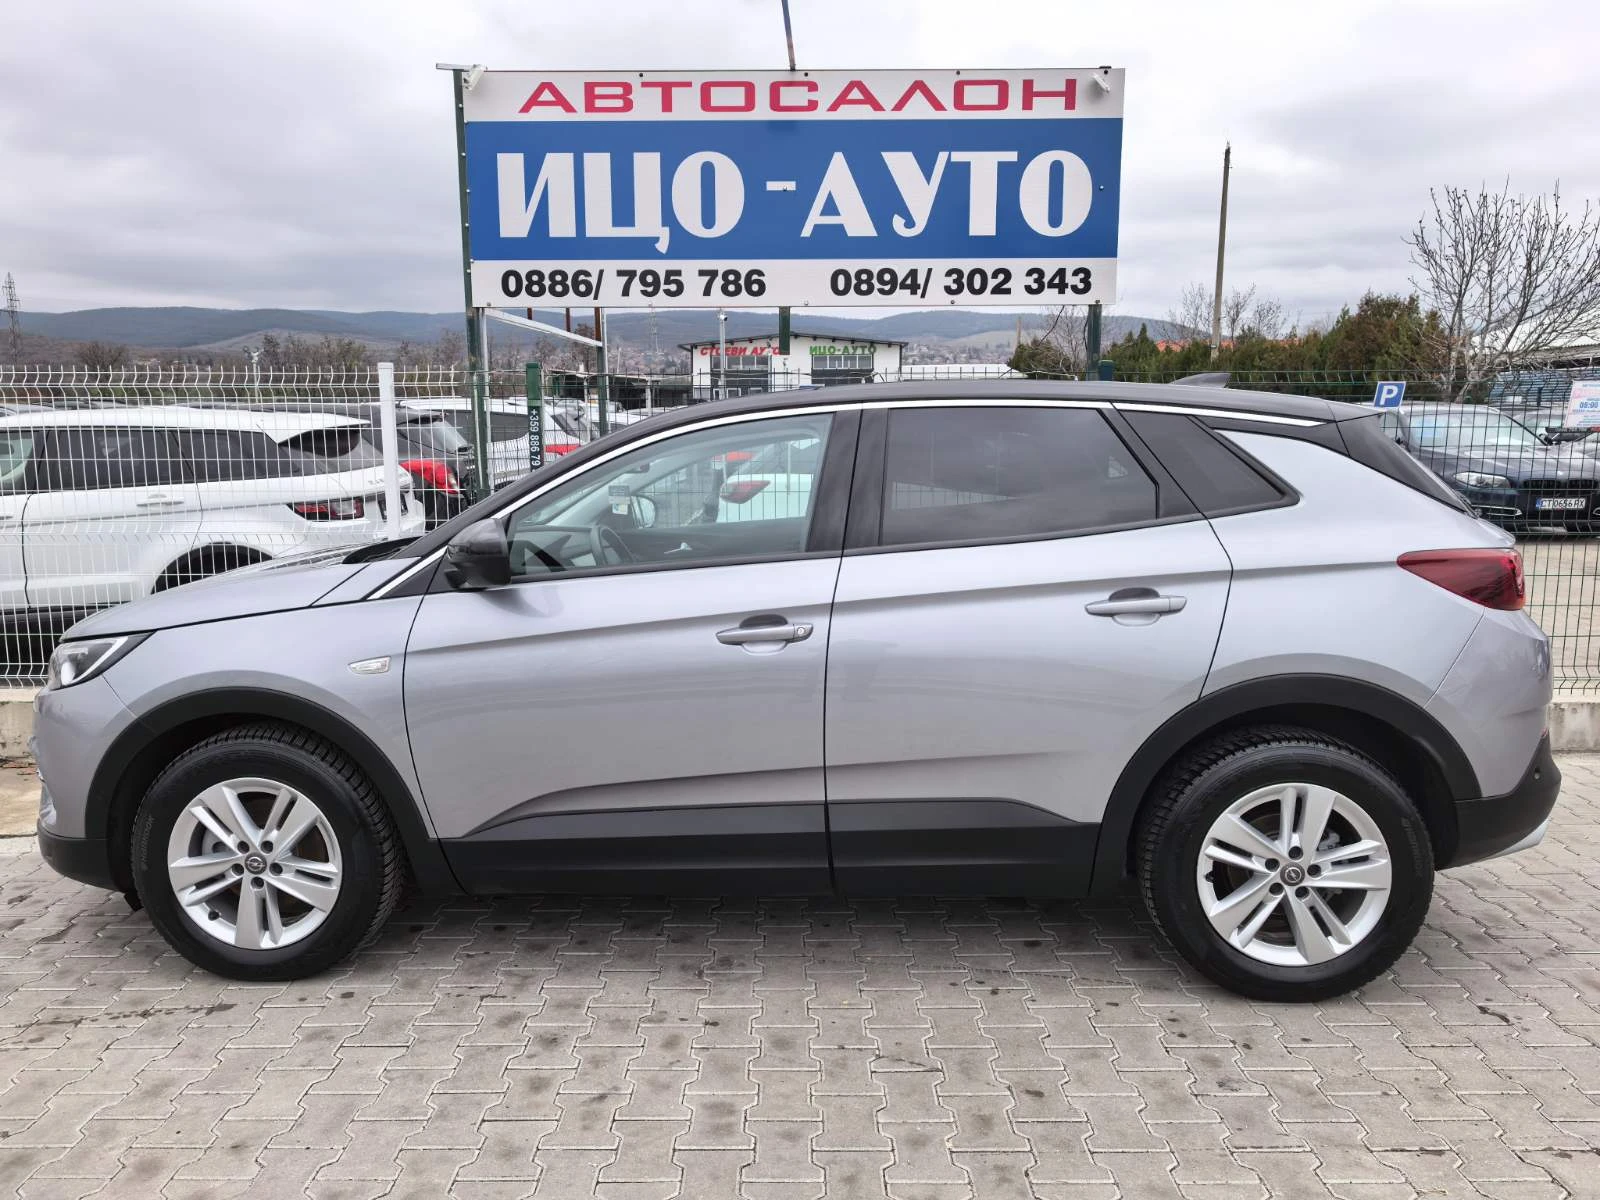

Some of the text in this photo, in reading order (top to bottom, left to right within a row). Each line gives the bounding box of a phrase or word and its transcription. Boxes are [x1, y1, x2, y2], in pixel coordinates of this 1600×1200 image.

[518, 79, 1076, 113] АВТОСАЛОН
[501, 269, 766, 300] 0886/ 795 786
[830, 267, 1092, 299] 0894/ 302 343
[1380, 385, 1398, 405] P
[529, 408, 539, 432] +359
[529, 435, 540, 452] 886
